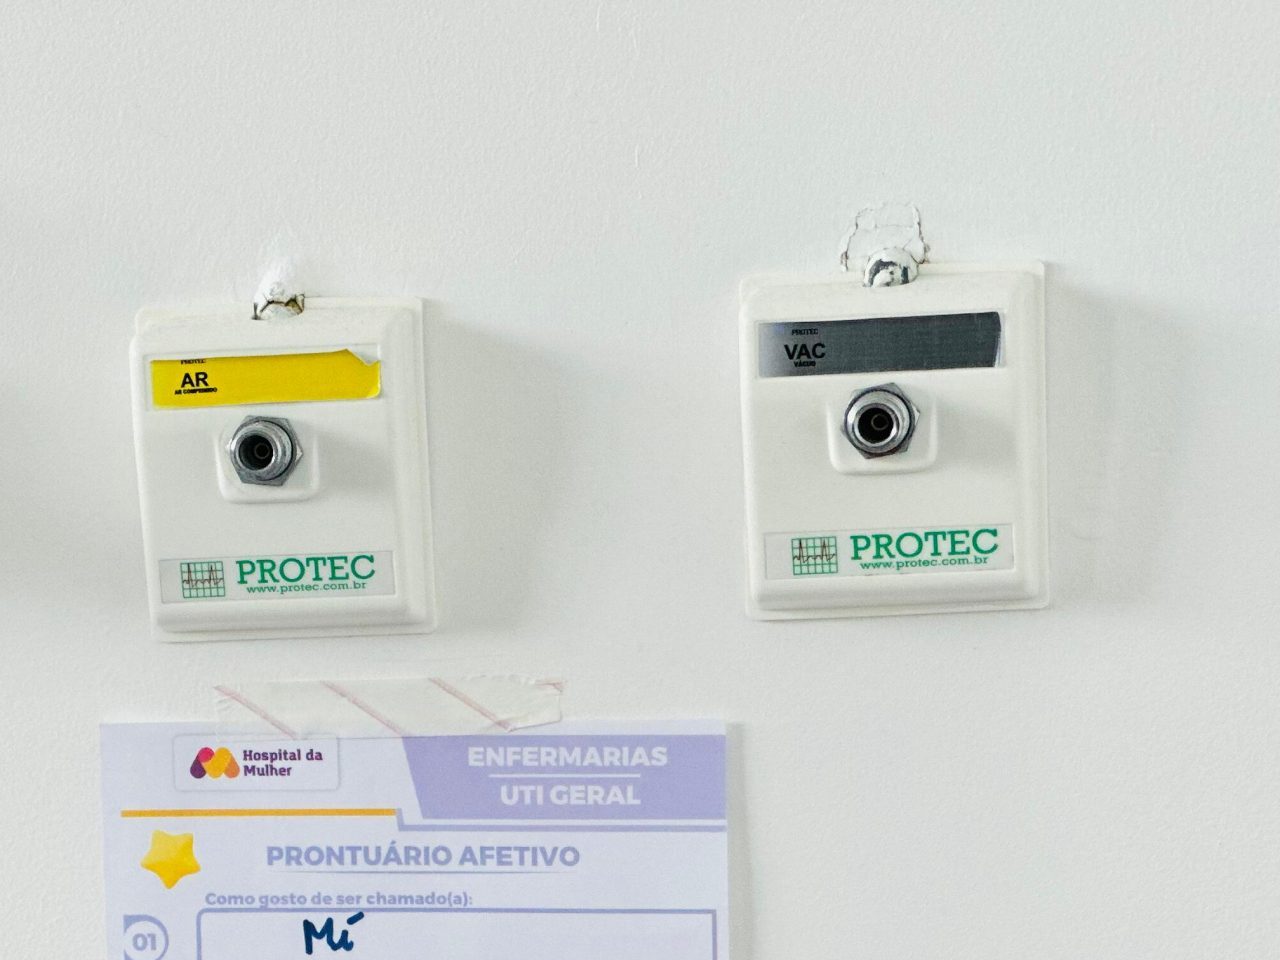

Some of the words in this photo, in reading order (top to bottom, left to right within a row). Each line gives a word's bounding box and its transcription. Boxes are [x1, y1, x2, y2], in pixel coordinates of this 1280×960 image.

[784, 342, 826, 360] VAC
[181, 372, 209, 388] AR
[850, 529, 999, 561] PROTEC
[236, 554, 375, 584] PROTEC
[860, 555, 988, 571] www.protec.com.br
[246, 580, 367, 595] www.protec.com.br
[243, 749, 301, 763] Hospital
[306, 749, 323, 761] da
[468, 747, 668, 766] ENFERMARIAS
[243, 764, 292, 776] Mulher
[500, 785, 544, 805] UTI
[550, 785, 641, 805] GERAL
[267, 840, 452, 866] PRONTUÁRIO
[458, 845, 580, 866] AFETIVO
[205, 893, 255, 905] Como
[259, 894, 307, 908] gosto
[311, 892, 331, 905] de
[336, 895, 362, 905] ser
[366, 891, 473, 907] chamado(a):
[132, 933, 157, 951] 01
